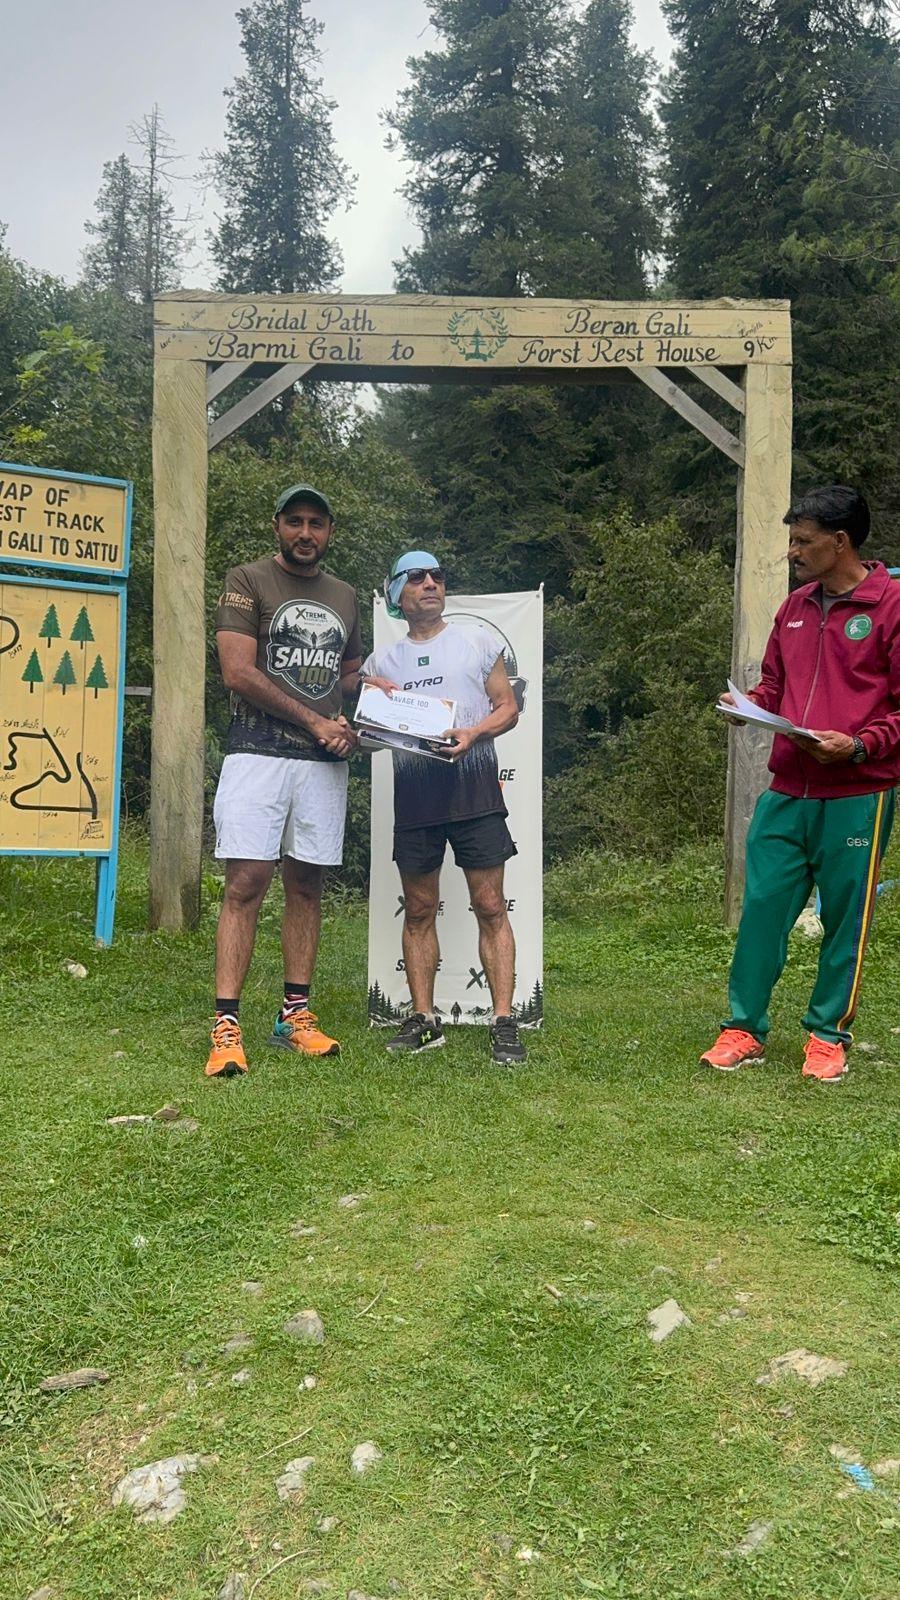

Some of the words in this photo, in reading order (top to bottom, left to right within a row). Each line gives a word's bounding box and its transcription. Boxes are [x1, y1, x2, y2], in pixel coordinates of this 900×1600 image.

[227, 304, 307, 331] Bridal
[316, 305, 376, 332] Path
[564, 308, 639, 335] Beran
[645, 311, 693, 336] Gali
[207, 332, 299, 360] Barmi
[305, 334, 363, 361] Gali
[387, 340, 414, 360] to
[517, 339, 582, 364] Forst
[587, 339, 644, 363] Rest
[656, 340, 721, 363] House
[744, 340, 755, 358] 9
[46, 487, 70, 507] OF
[44, 510, 105, 533] TRACK
[8, 531, 42, 553] GALI
[50, 536, 69, 556] TO
[75, 539, 118, 563] SATTU
[295, 607, 327, 620] XTREME
[275, 646, 340, 672] SAVAGE
[298, 666, 330, 685] 100
[403, 676, 443, 691] GYRO
[392, 695, 415, 705] AVAGE
[846, 837, 869, 847] GBS
